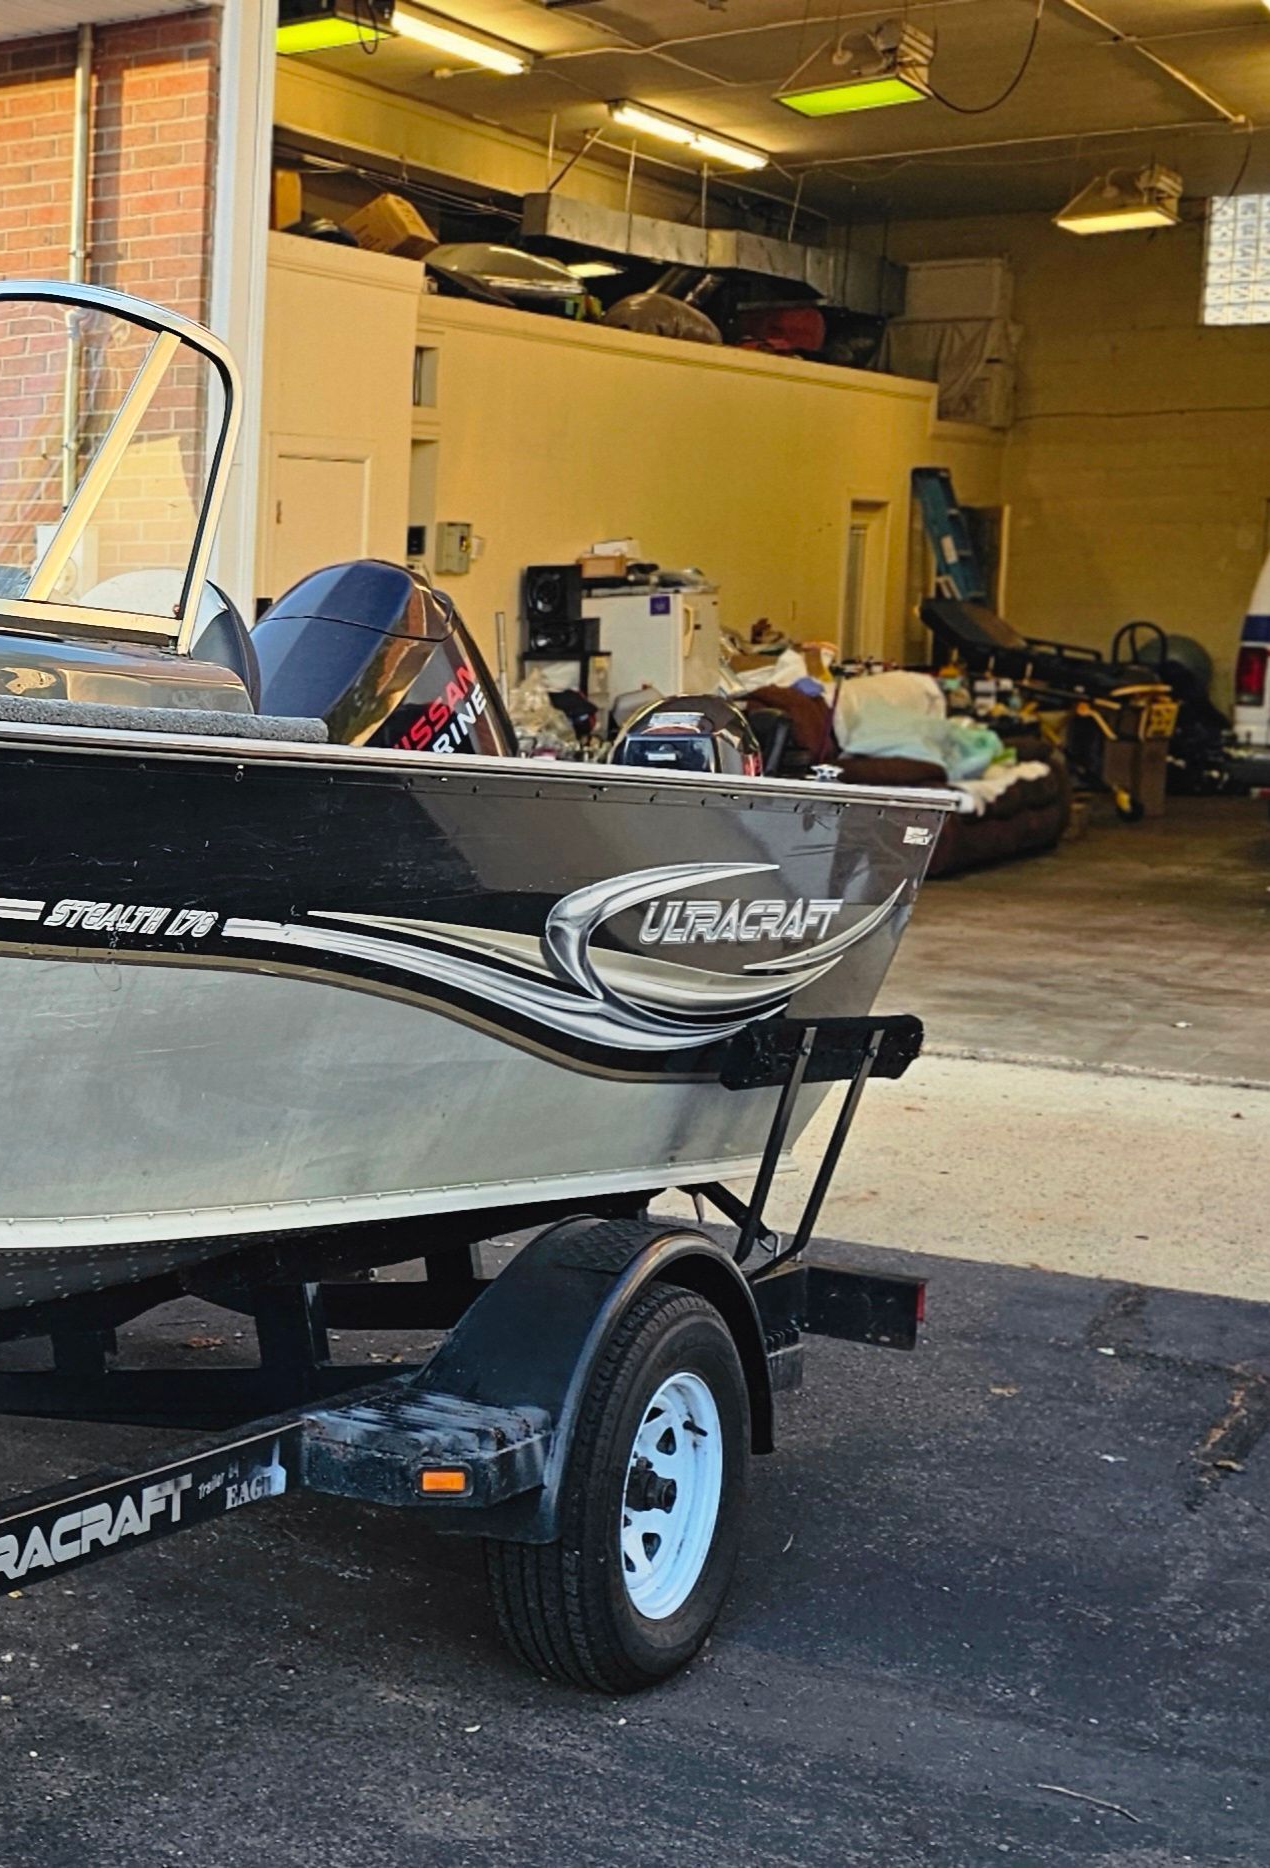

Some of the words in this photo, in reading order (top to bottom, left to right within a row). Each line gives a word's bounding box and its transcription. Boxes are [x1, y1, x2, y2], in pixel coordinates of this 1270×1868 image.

[394, 662, 477, 750] ISSAN
[432, 682, 487, 753] RINE
[43, 899, 172, 934] STEALTH
[639, 898, 844, 944] ULTRACRAFT
